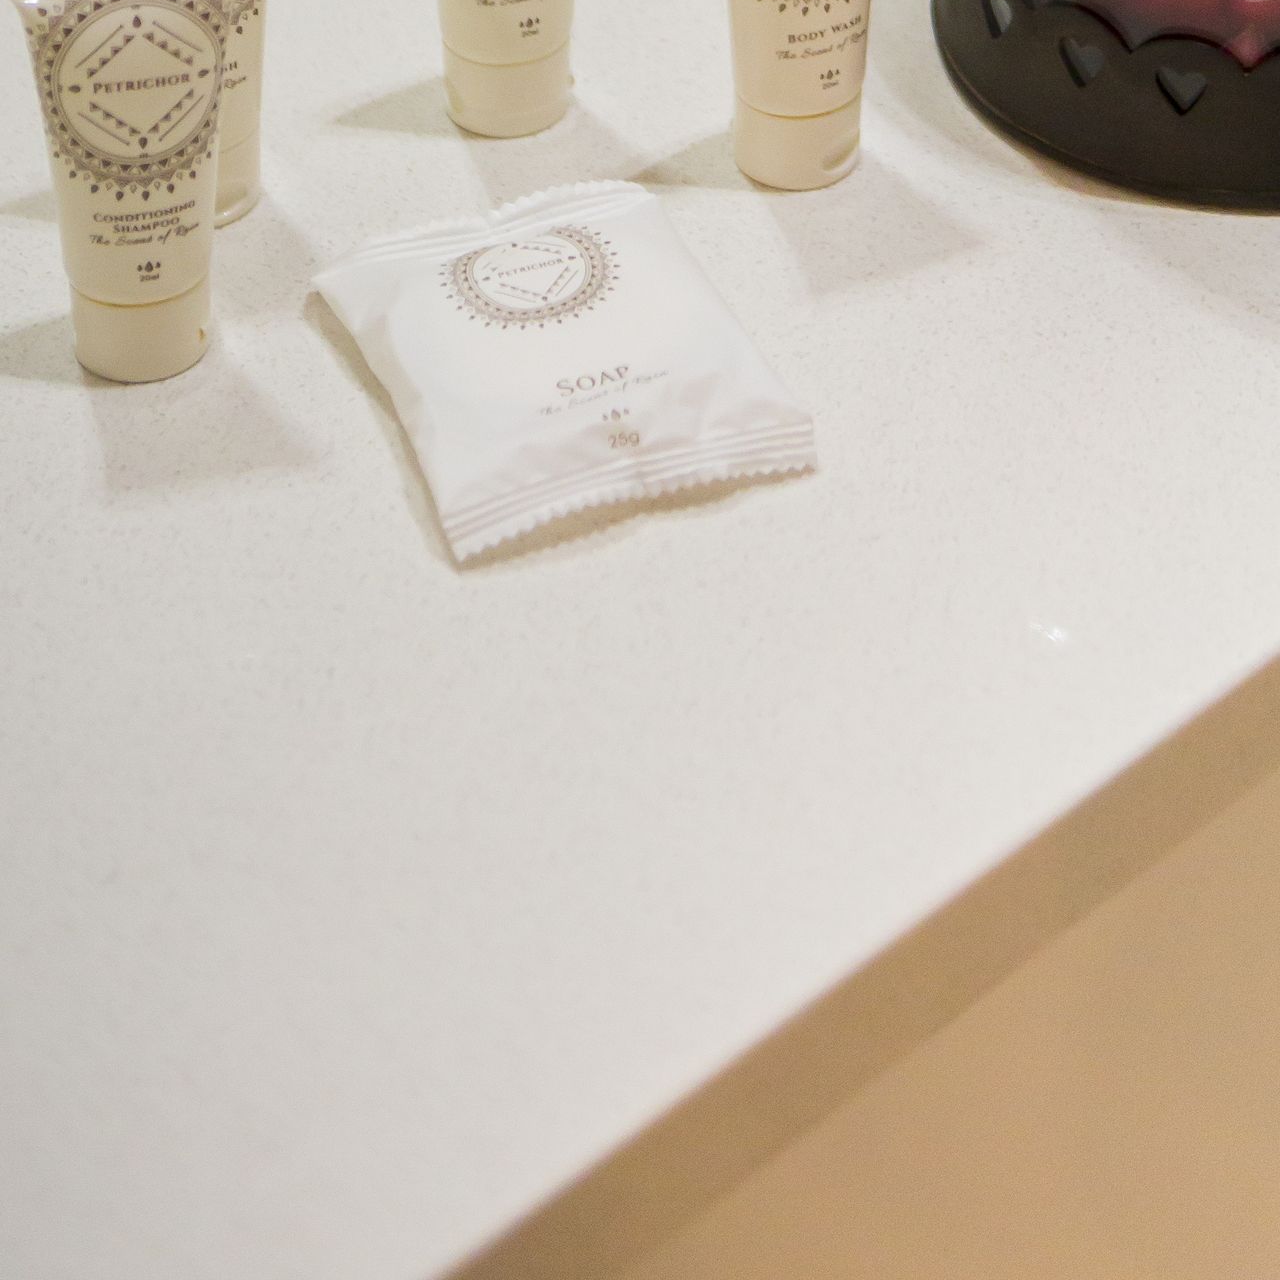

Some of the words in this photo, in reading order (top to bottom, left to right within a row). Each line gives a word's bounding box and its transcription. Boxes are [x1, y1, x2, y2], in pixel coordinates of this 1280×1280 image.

[787, 29, 827, 44] BODY
[831, 14, 862, 33] WASH
[92, 73, 191, 94] PETRICHOR
[93, 200, 196, 224] CONDITIONING
[113, 217, 180, 234] SHAMPOO
[497, 258, 564, 280] PETRICHOR
[555, 366, 629, 398] SOAP
[608, 432, 641, 450] 25g
